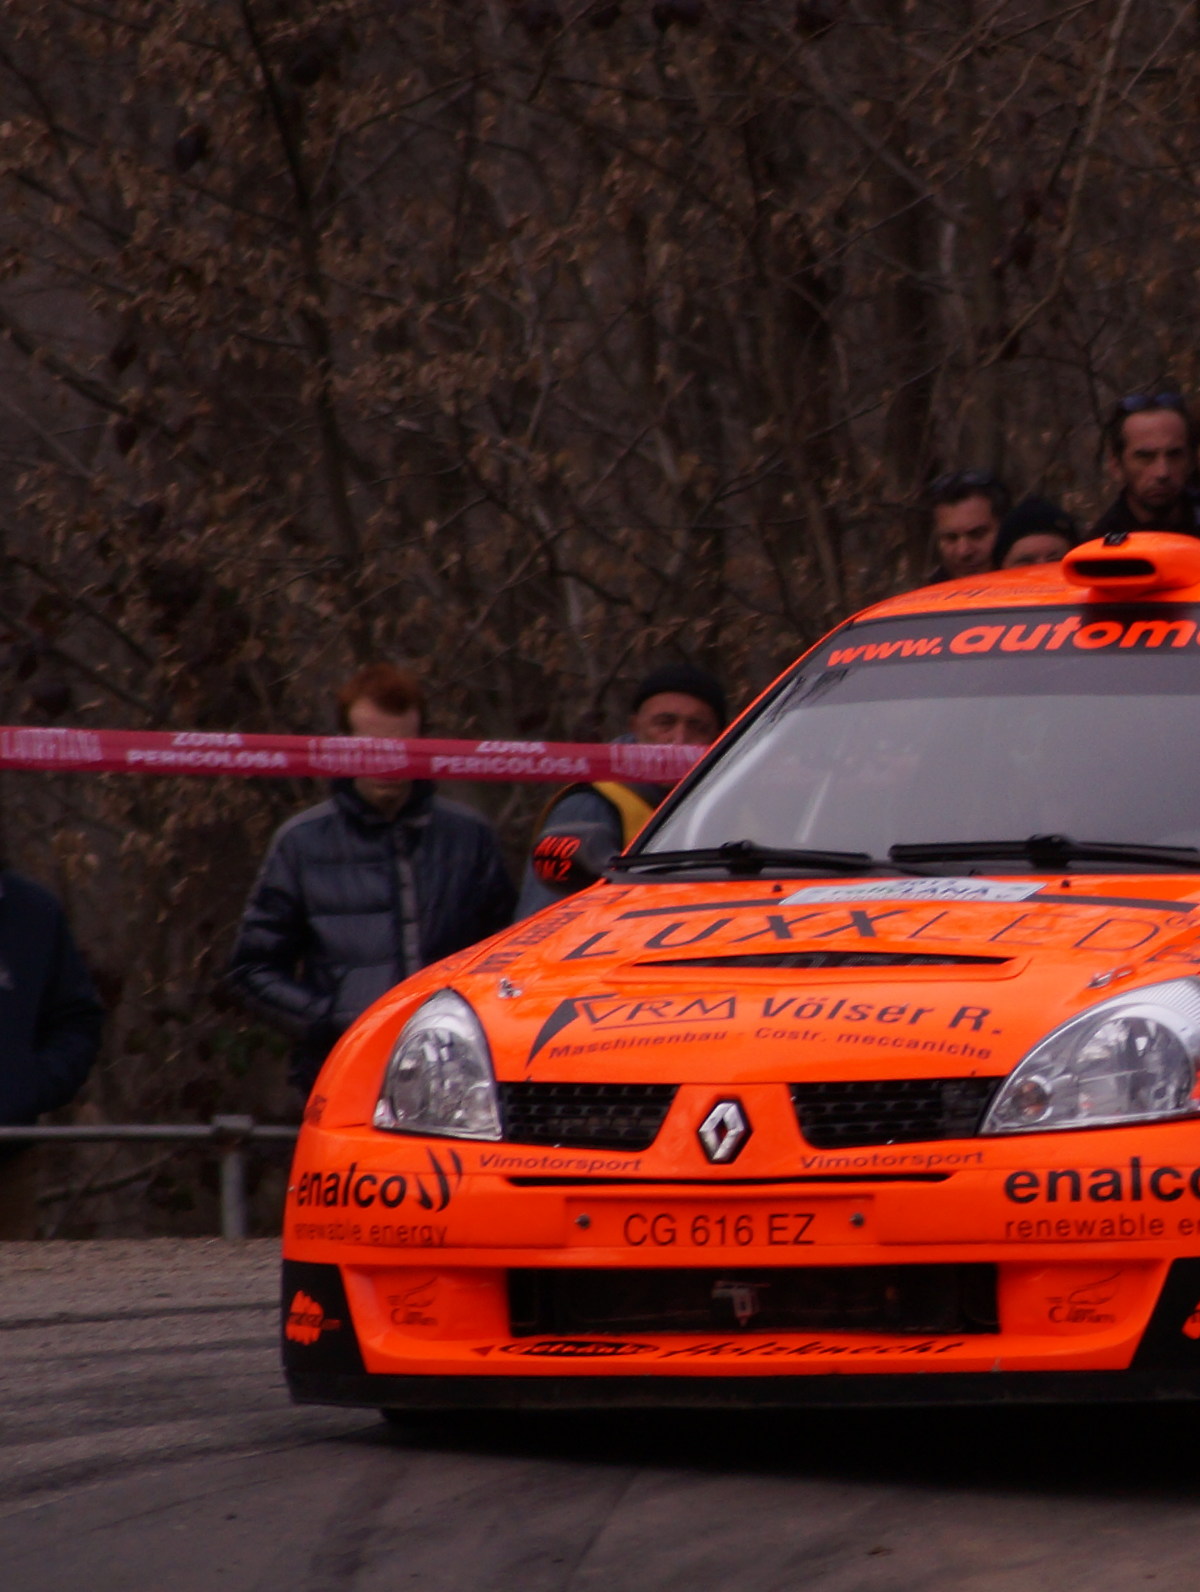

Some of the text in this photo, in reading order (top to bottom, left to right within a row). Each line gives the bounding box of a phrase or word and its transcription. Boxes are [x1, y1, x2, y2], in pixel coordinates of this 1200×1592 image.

[127, 749, 288, 769] PERICOLOSA
[431, 755, 590, 776] PERICOLOSA
[761, 995, 936, 1027] Völser
[946, 1005, 1002, 1035] R.
[549, 1026, 992, 1061] Maschinenbau Costr. meccaniche
[478, 1151, 643, 1173] Vimotorsport
[800, 1149, 984, 1169] Vimotorsport
[297, 1162, 407, 1208] enalco
[369, 1224, 448, 1246] energy
[623, 1213, 816, 1247] CG 616 EZ
[1005, 1213, 1164, 1238] renewable
